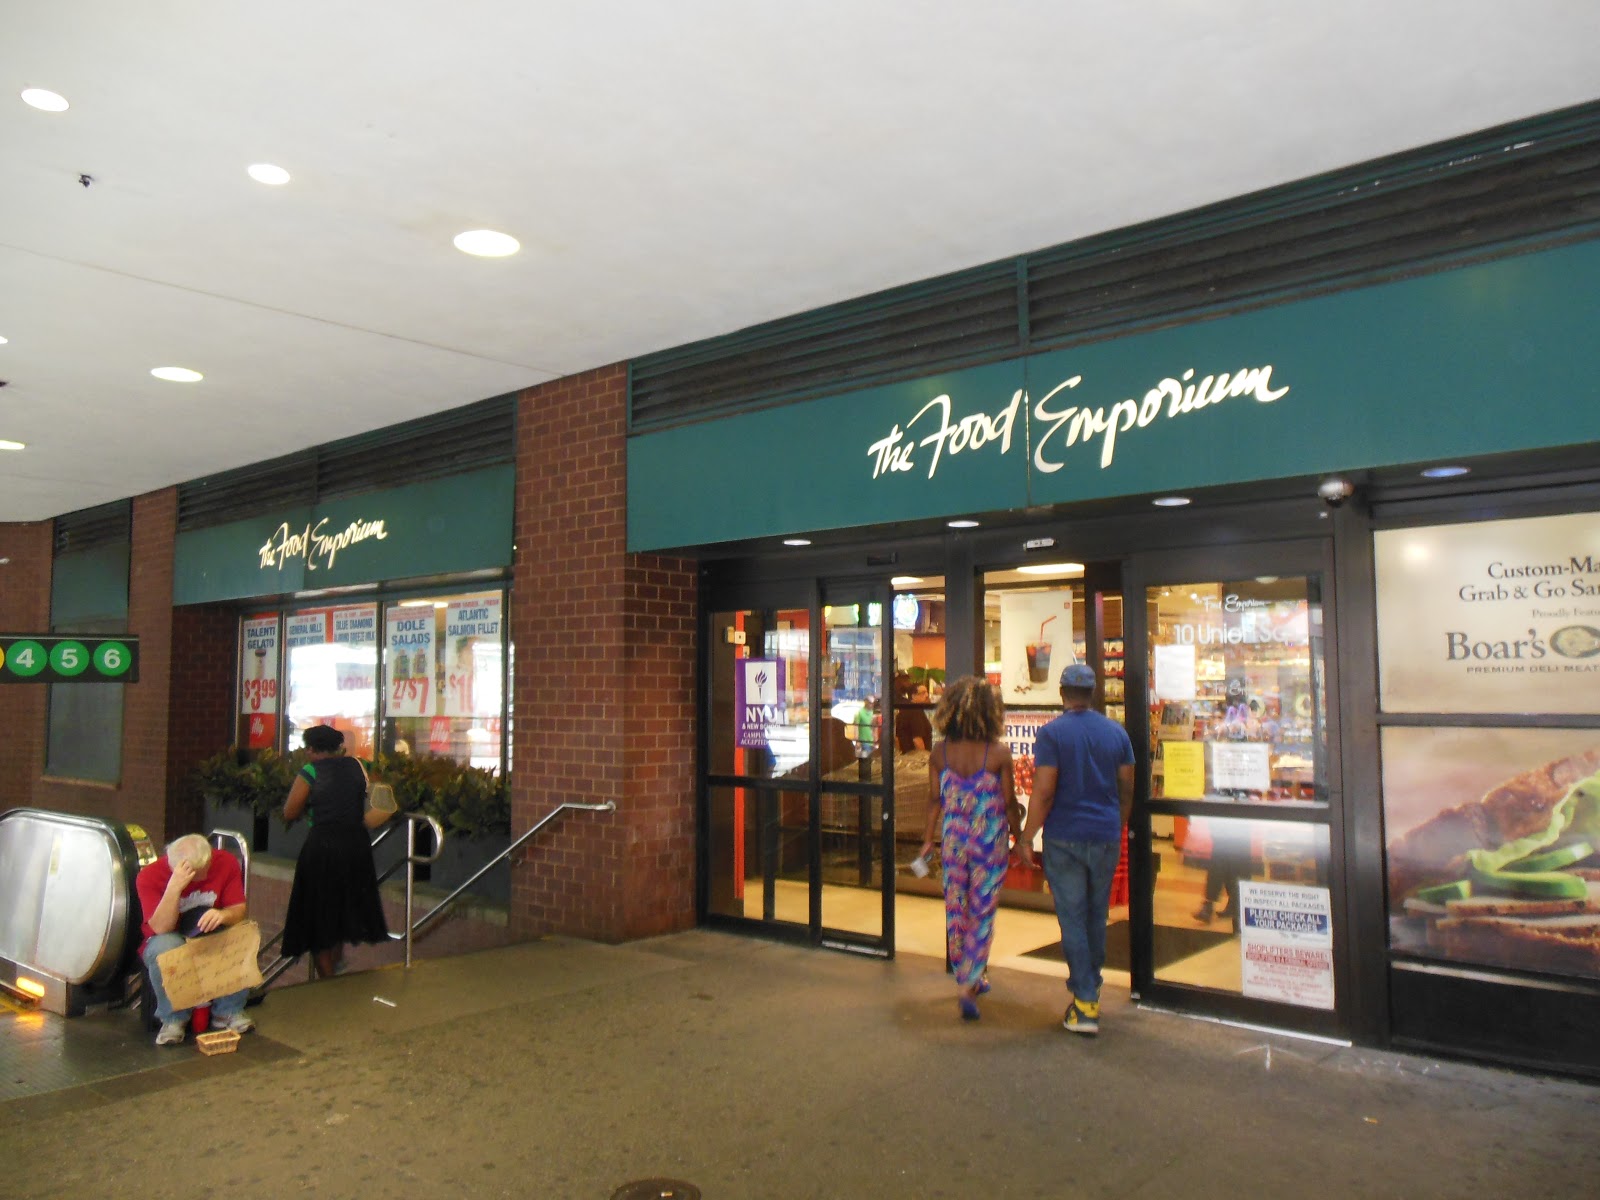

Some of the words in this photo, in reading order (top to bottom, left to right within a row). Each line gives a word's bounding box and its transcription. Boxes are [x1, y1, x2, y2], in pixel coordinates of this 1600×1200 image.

[866, 424, 915, 479] The
[906, 388, 1023, 480] Food
[1033, 364, 1290, 474] Emporium
[258, 537, 276, 569] The
[273, 521, 311, 571] Food
[307, 516, 388, 571] Emporium
[1458, 584, 1509, 602] Grab
[1513, 586, 1529, 600] &
[1533, 580, 1566, 600] Go
[458, 607, 489, 622] ATLANTIC
[247, 626, 276, 639] TALENTI
[396, 619, 426, 633] DOLE
[448, 624, 475, 637] SALMON
[477, 621, 498, 635] FILLET
[391, 632, 431, 647] SALADS
[1173, 623, 1195, 646] 10
[247, 638, 275, 650] GELATO
[1444, 628, 1547, 661] Boar's
[15, 648, 35, 668] 4
[61, 648, 79, 669] 5
[103, 648, 121, 669] 6
[1466, 665, 1526, 674] PREMIUM
[1529, 665, 1560, 673] DELI
[745, 705, 779, 724] NYU
[1249, 908, 1278, 920] PLEASE
[1279, 911, 1306, 922] CHECK
[1254, 918, 1275, 928] YOUR
